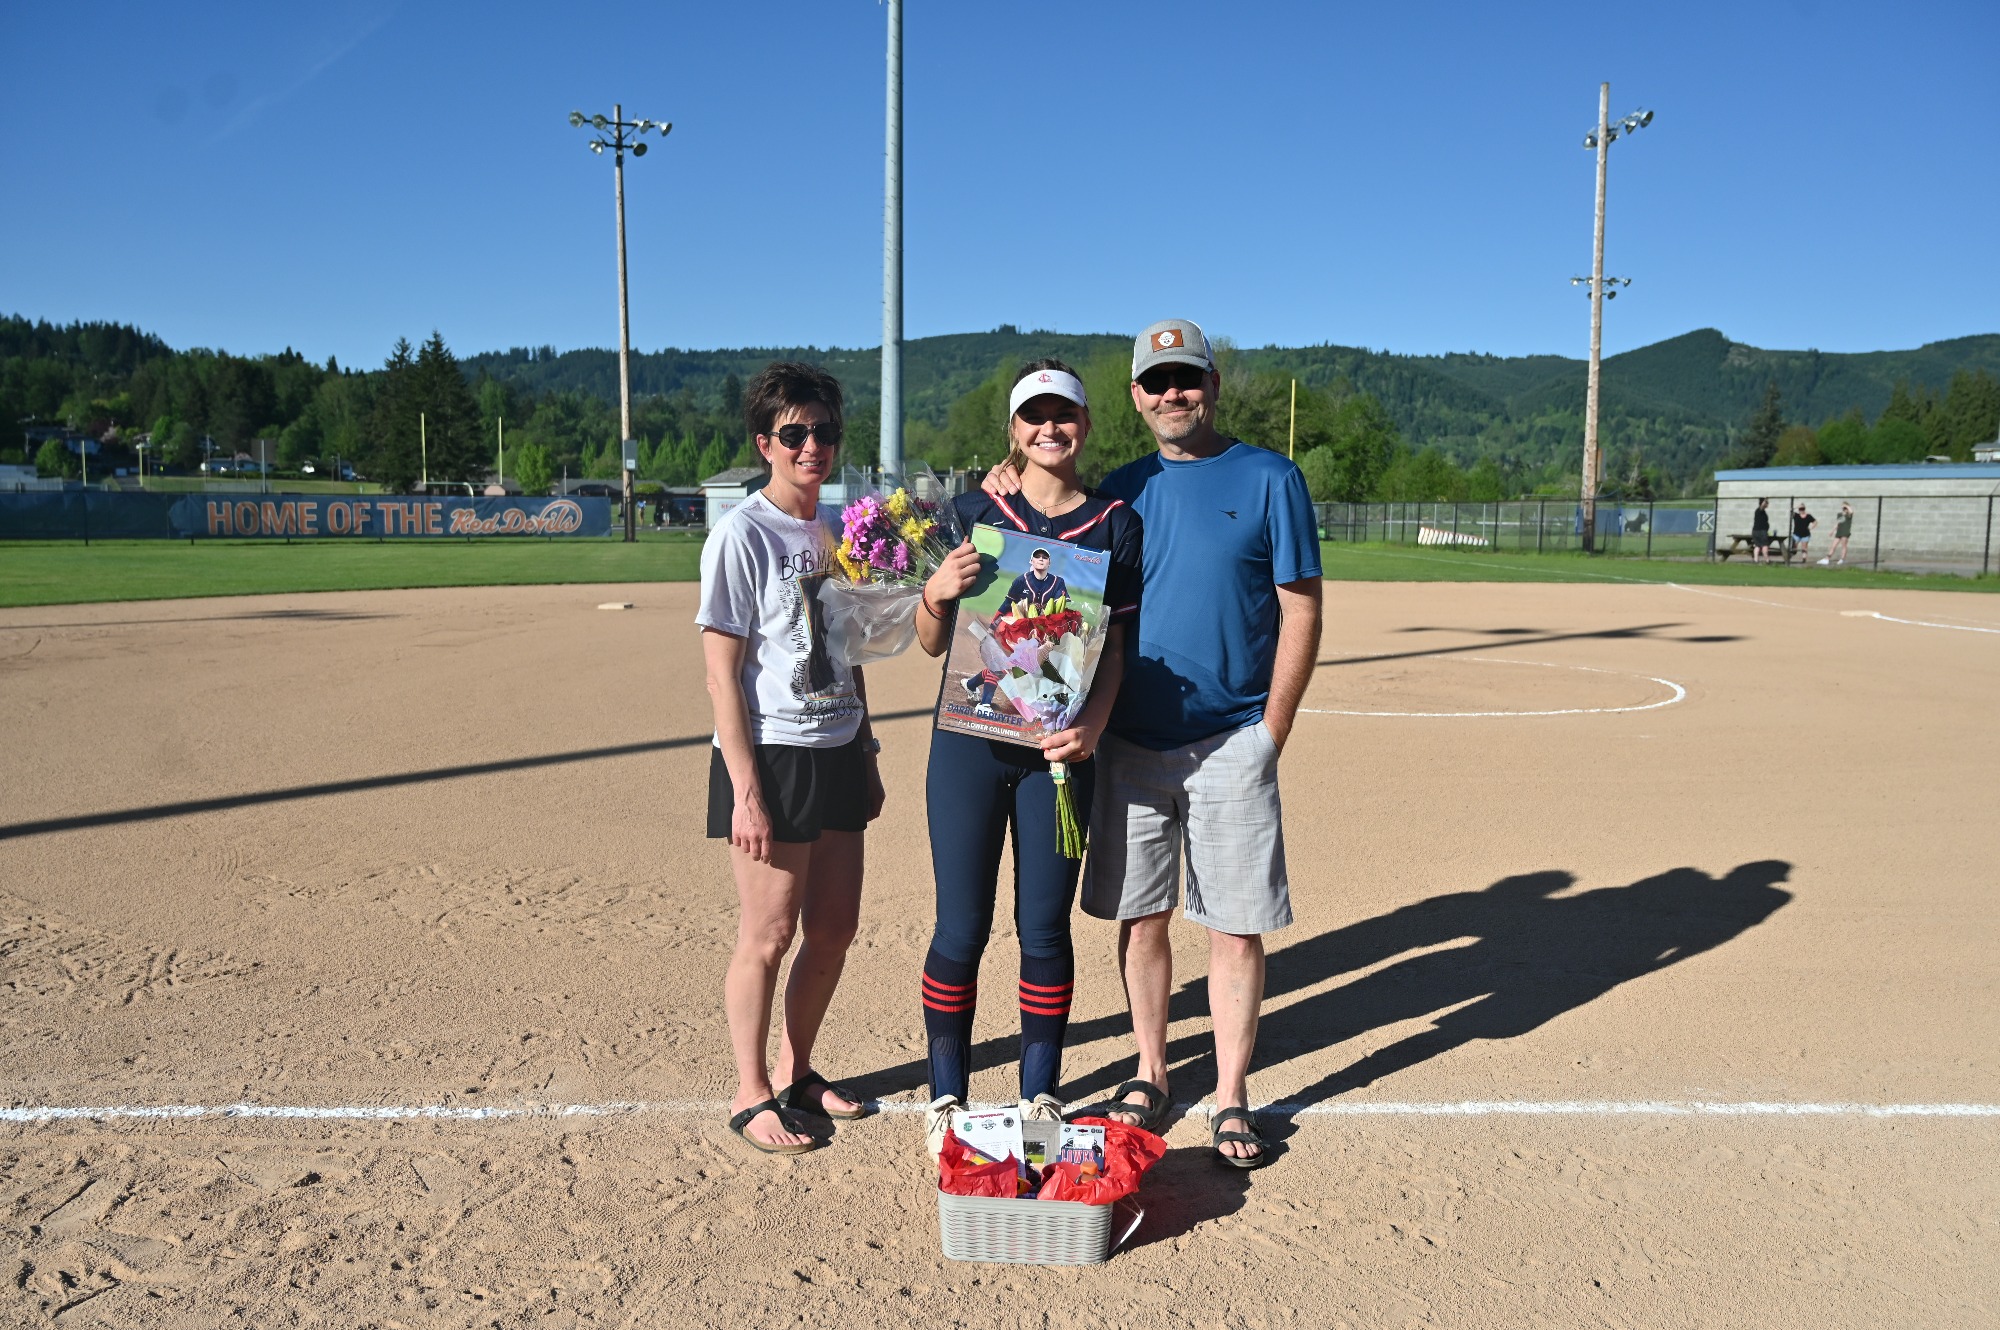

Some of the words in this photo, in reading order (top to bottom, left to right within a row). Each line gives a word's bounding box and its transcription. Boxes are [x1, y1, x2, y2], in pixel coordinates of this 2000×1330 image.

[206, 501, 319, 535] HOME
[327, 502, 371, 534] OF
[377, 503, 443, 534] THE
[450, 508, 500, 534] Red
[498, 500, 582, 534] Devils
[779, 549, 815, 581] BOB
[788, 619, 811, 656] JAMAICA
[789, 657, 808, 702] KINGSTON
[966, 721, 988, 732] LOWER
[989, 725, 1020, 738] COLUMBIA
[1060, 1148, 1095, 1164] LOWER
